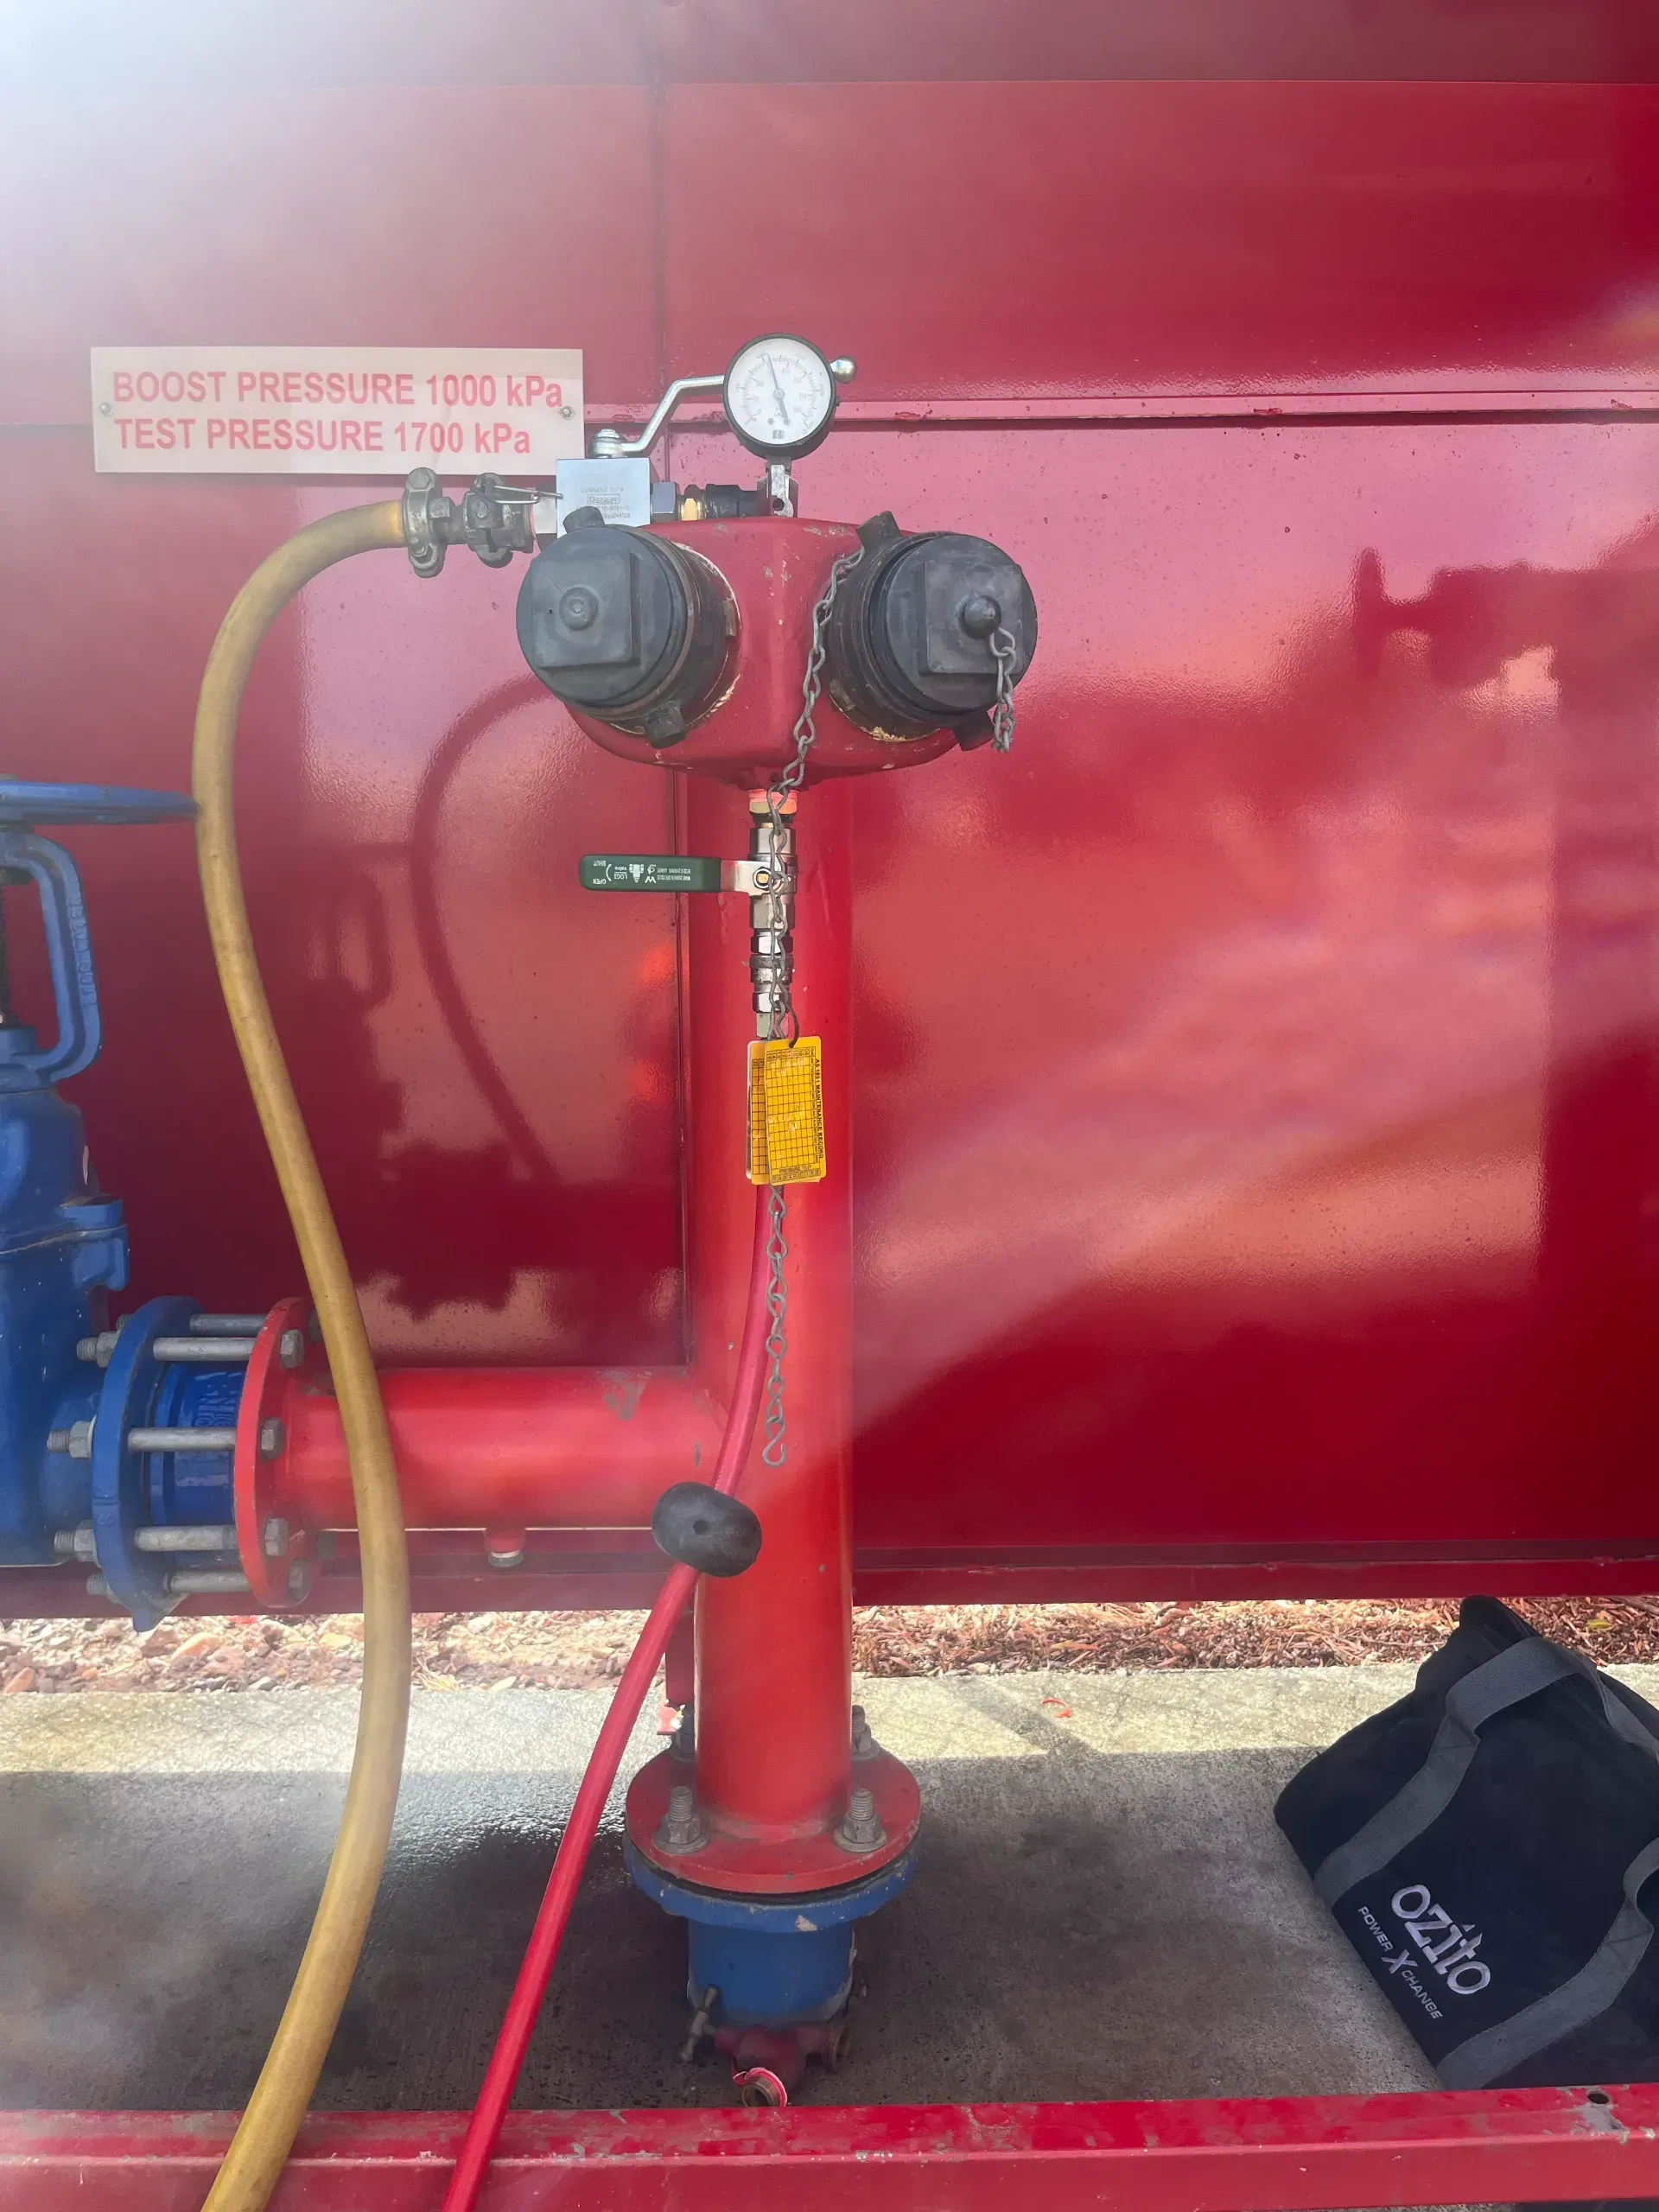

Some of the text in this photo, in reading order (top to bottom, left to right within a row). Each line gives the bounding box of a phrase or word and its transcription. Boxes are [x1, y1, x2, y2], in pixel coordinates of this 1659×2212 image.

[112, 371, 563, 408] BOOST PRESSURE 1000 kPa
[114, 418, 531, 454] TEST PRESSURE 1700 kPa
[1357, 1905, 1394, 1951] POWER
[1402, 1969, 1443, 2019] CHANGE
